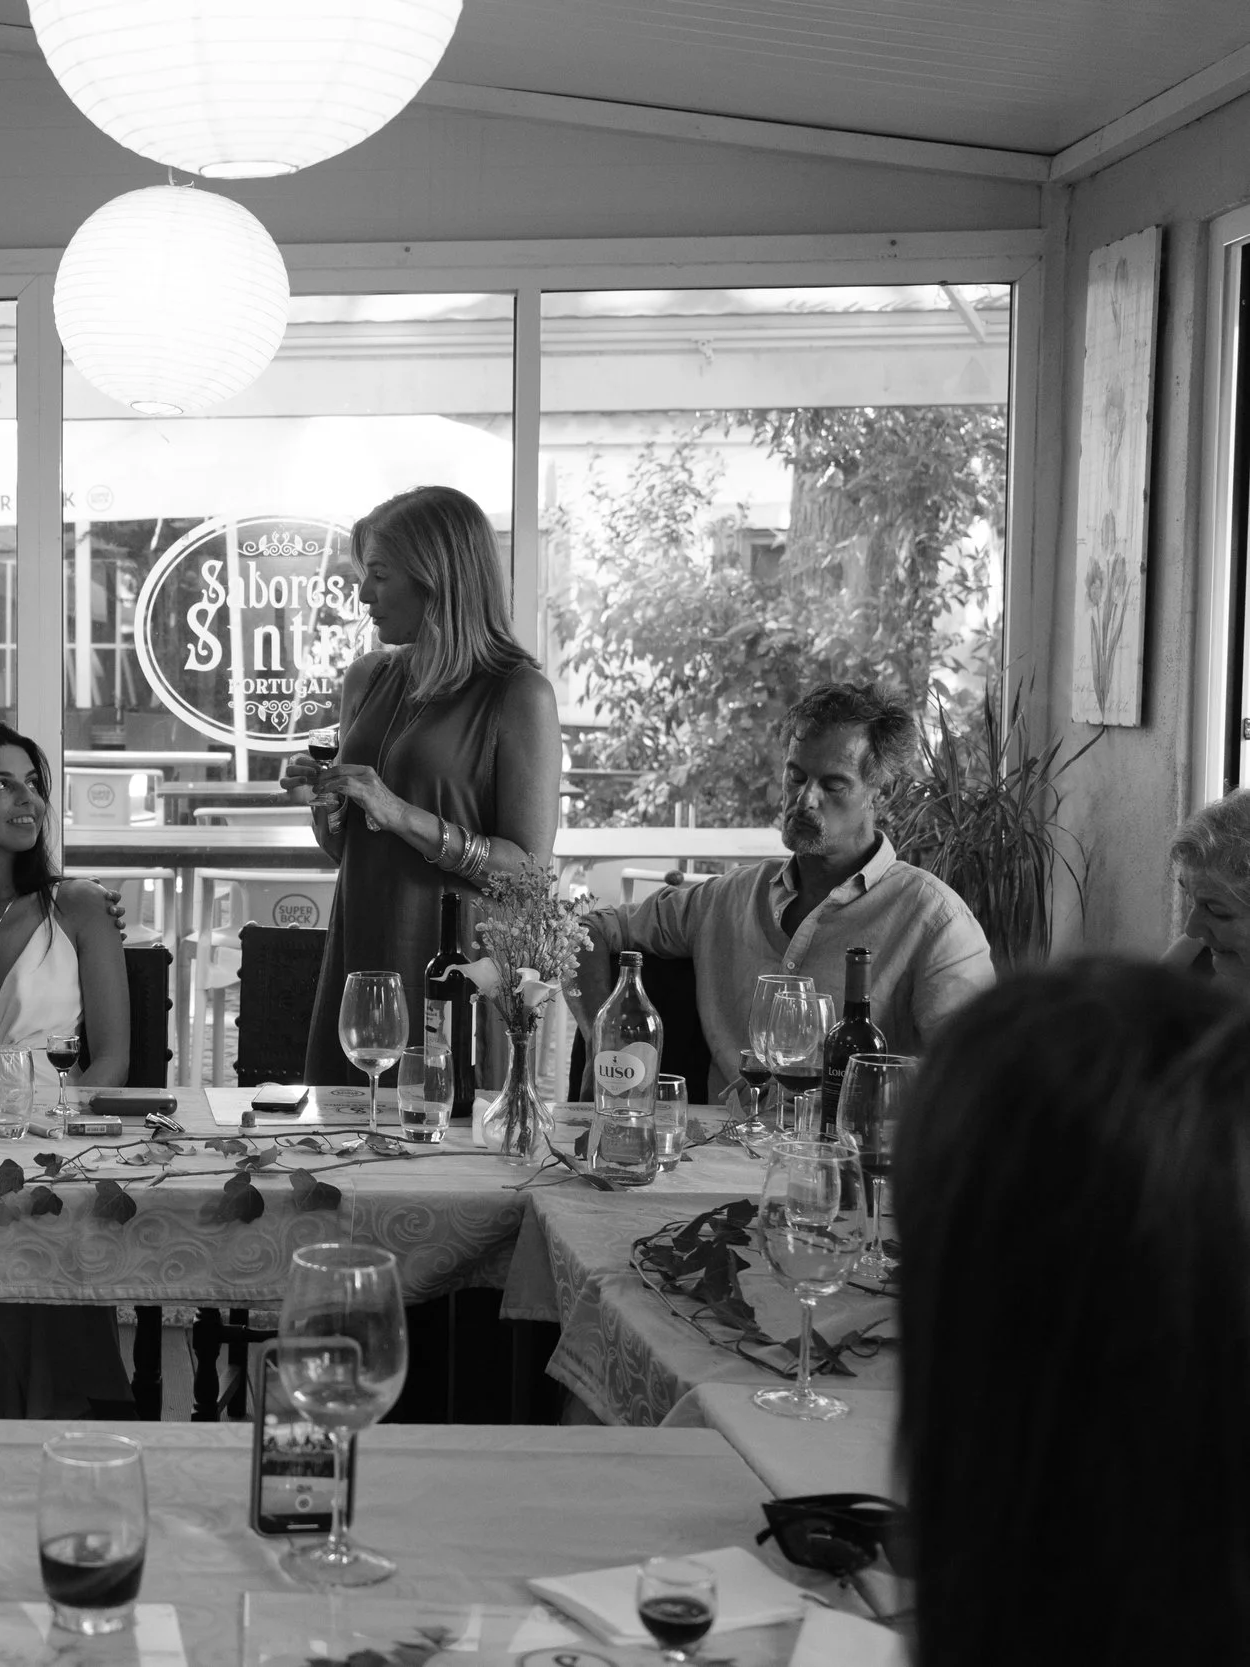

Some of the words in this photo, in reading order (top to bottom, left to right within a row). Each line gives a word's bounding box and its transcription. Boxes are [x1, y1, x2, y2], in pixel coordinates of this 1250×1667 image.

[201, 559, 345, 609] Sabores
[279, 905, 313, 915] SUPER
[280, 914, 311, 923] BOCK
[599, 1064, 635, 1079] LUSO
